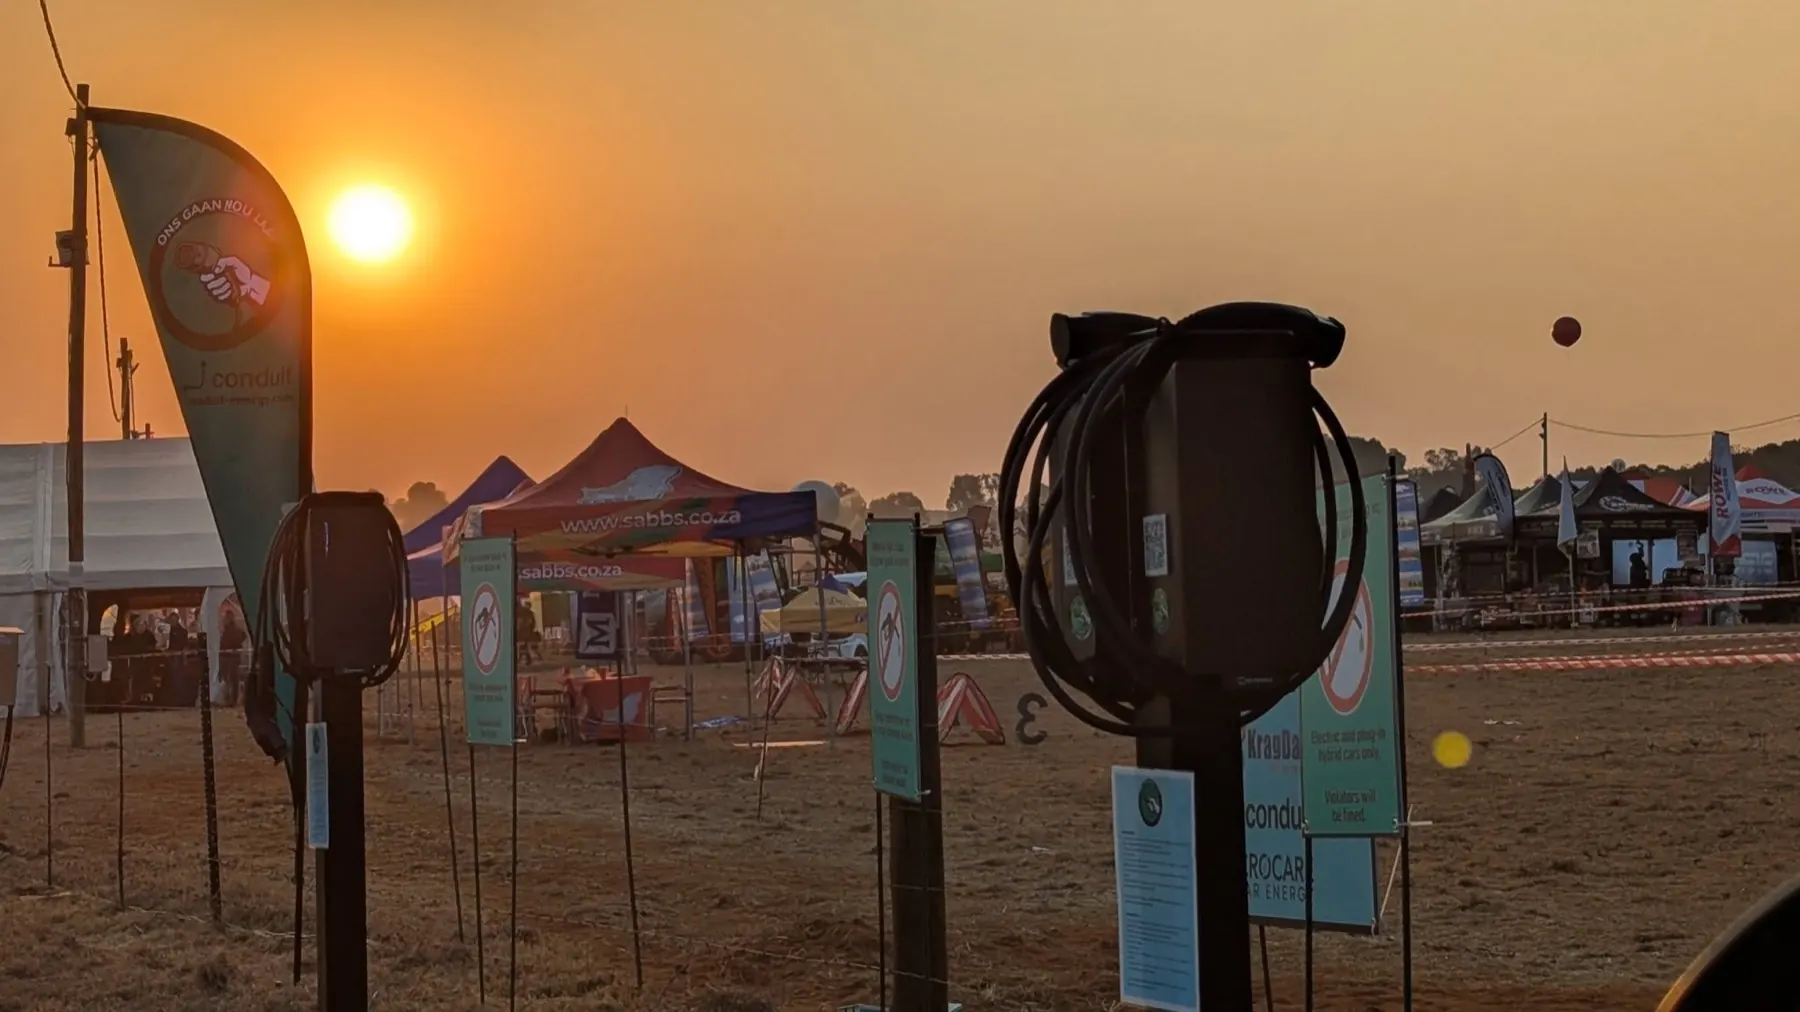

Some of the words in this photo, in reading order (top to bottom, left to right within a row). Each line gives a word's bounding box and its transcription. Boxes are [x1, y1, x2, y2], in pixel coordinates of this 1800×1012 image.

[157, 217, 182, 246] ONS
[182, 199, 222, 221] GAAN
[213, 366, 293, 388] conduit
[1712, 464, 1730, 518] ROWE
[560, 509, 742, 534] www.sabbs.co.za
[517, 564, 623, 581] .sabbs.co.za
[1247, 728, 1302, 761] KragDa
[1245, 797, 1303, 830] condu
[1247, 852, 1305, 882] ROCAR
[1265, 883, 1306, 903] ENERG
